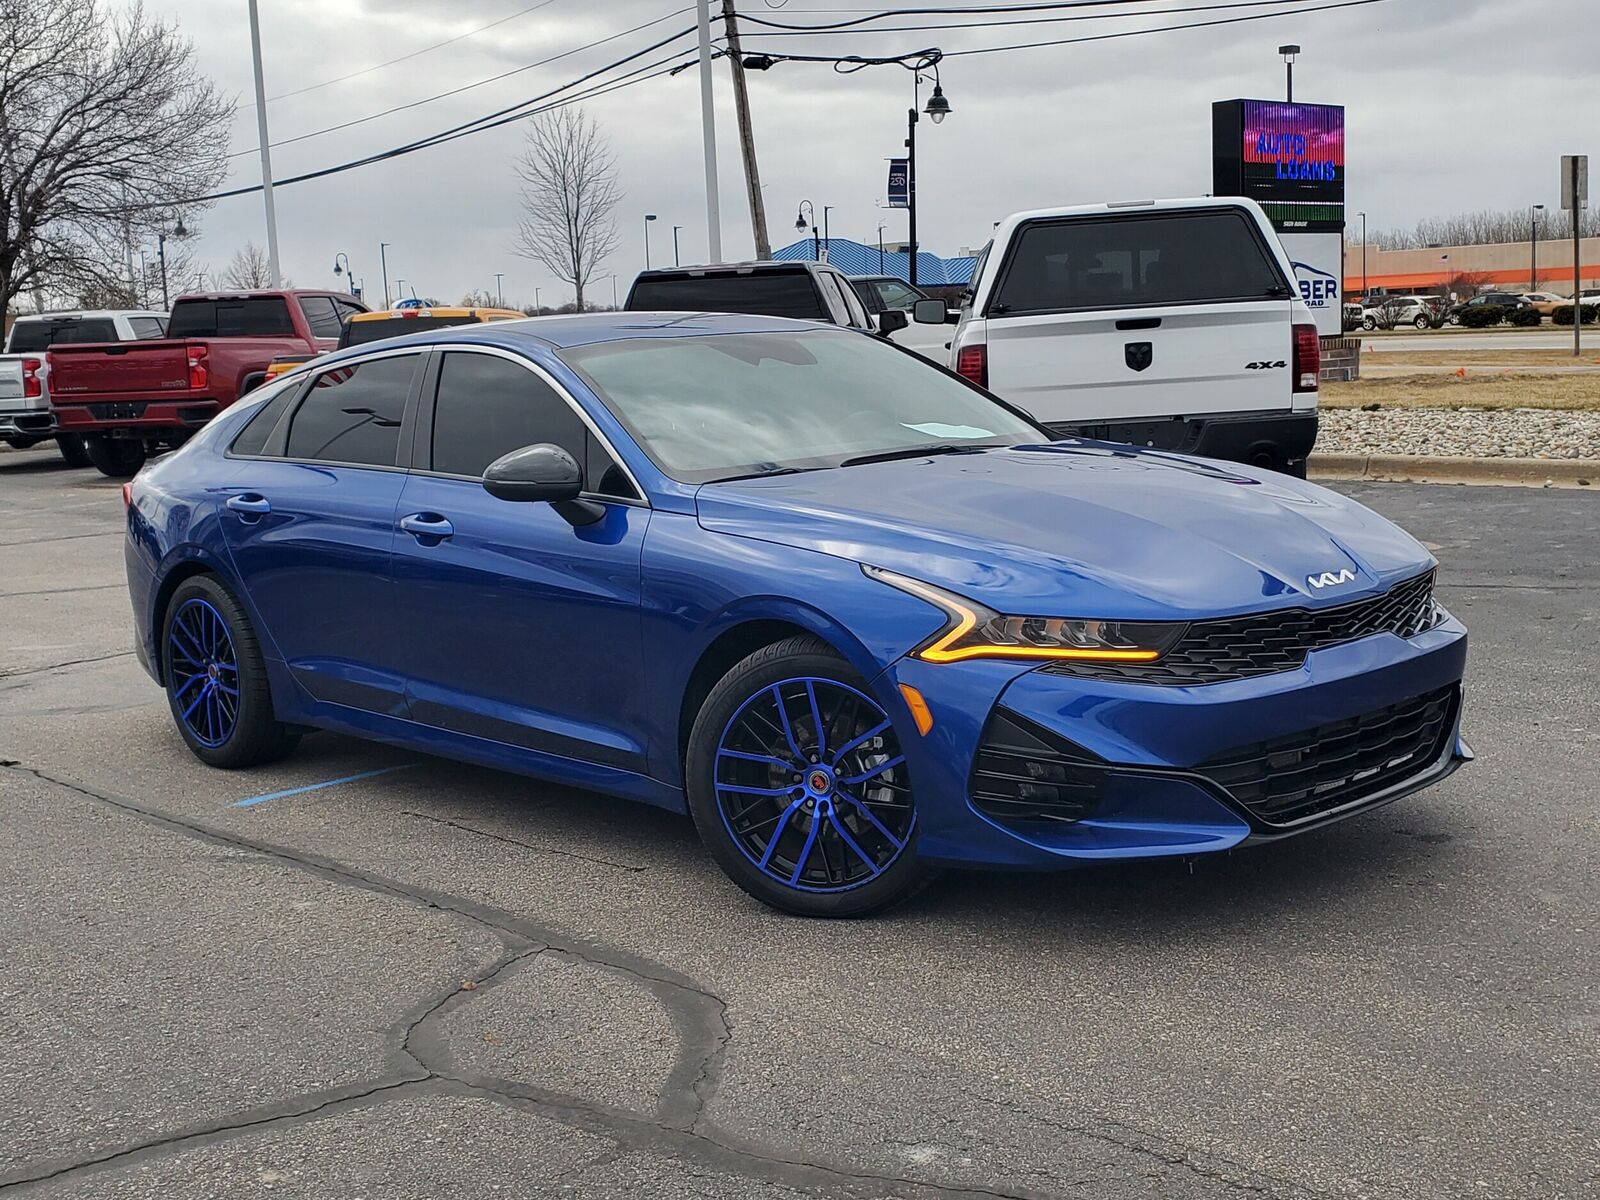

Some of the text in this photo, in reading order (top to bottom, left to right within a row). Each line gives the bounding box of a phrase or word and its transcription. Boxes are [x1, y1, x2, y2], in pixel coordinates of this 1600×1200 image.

[1257, 132, 1305, 156] AUTO
[1276, 159, 1335, 181] LOANS
[1307, 568, 1355, 588] KIA
